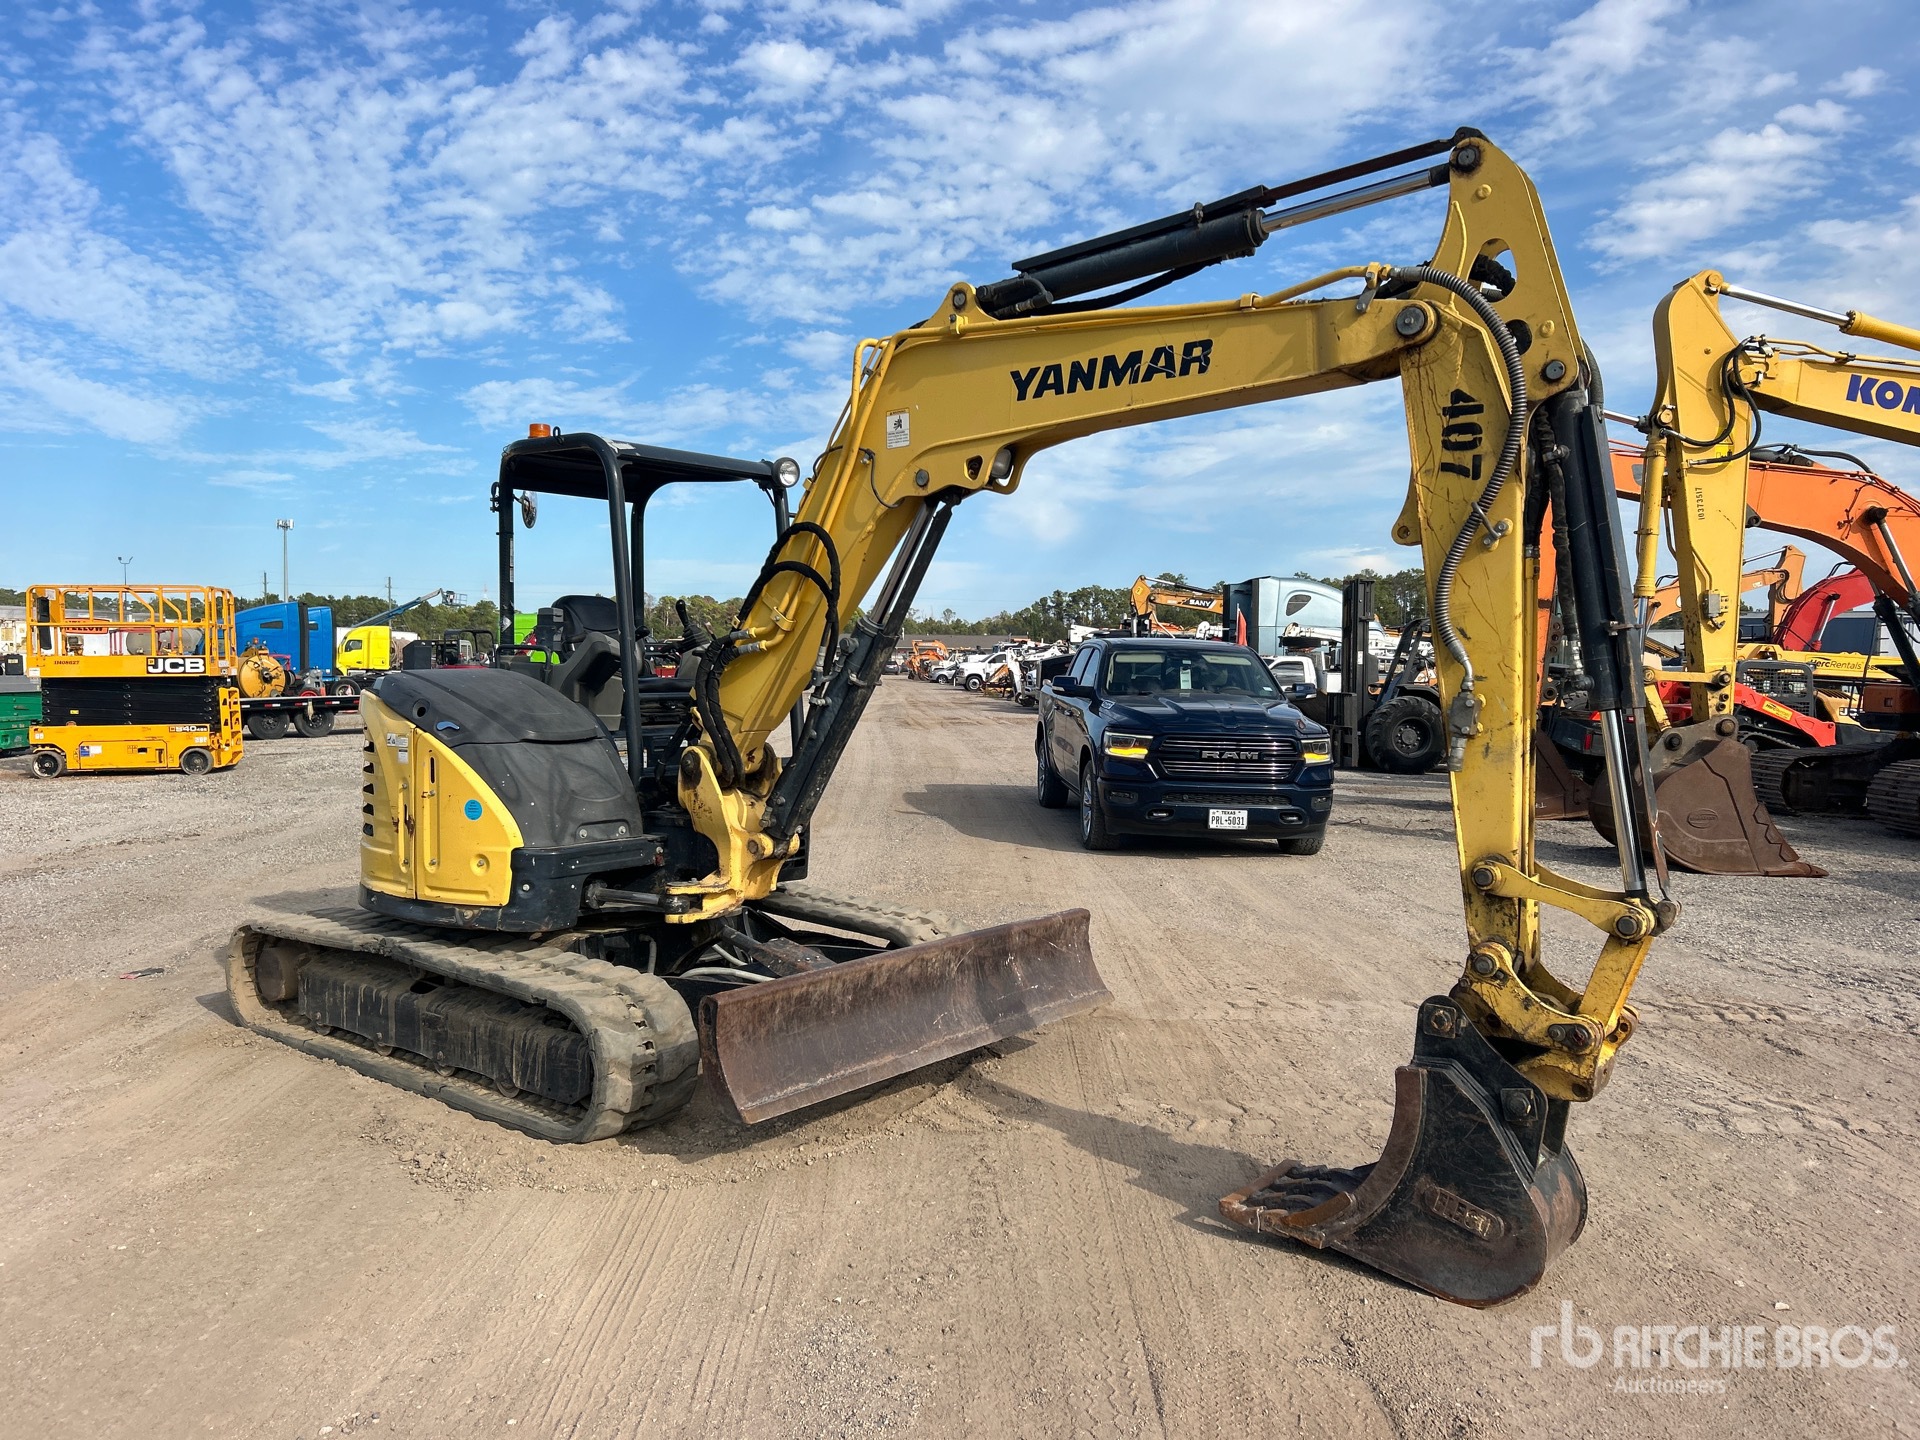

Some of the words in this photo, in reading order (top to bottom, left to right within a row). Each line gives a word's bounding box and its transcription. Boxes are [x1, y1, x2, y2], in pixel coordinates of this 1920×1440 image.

[1010, 338, 1214, 402] YANMAR
[1440, 388, 1484, 481] 407
[1189, 598, 1212, 608] SANY
[147, 658, 206, 674] JCB
[1201, 750, 1260, 760] RAM
